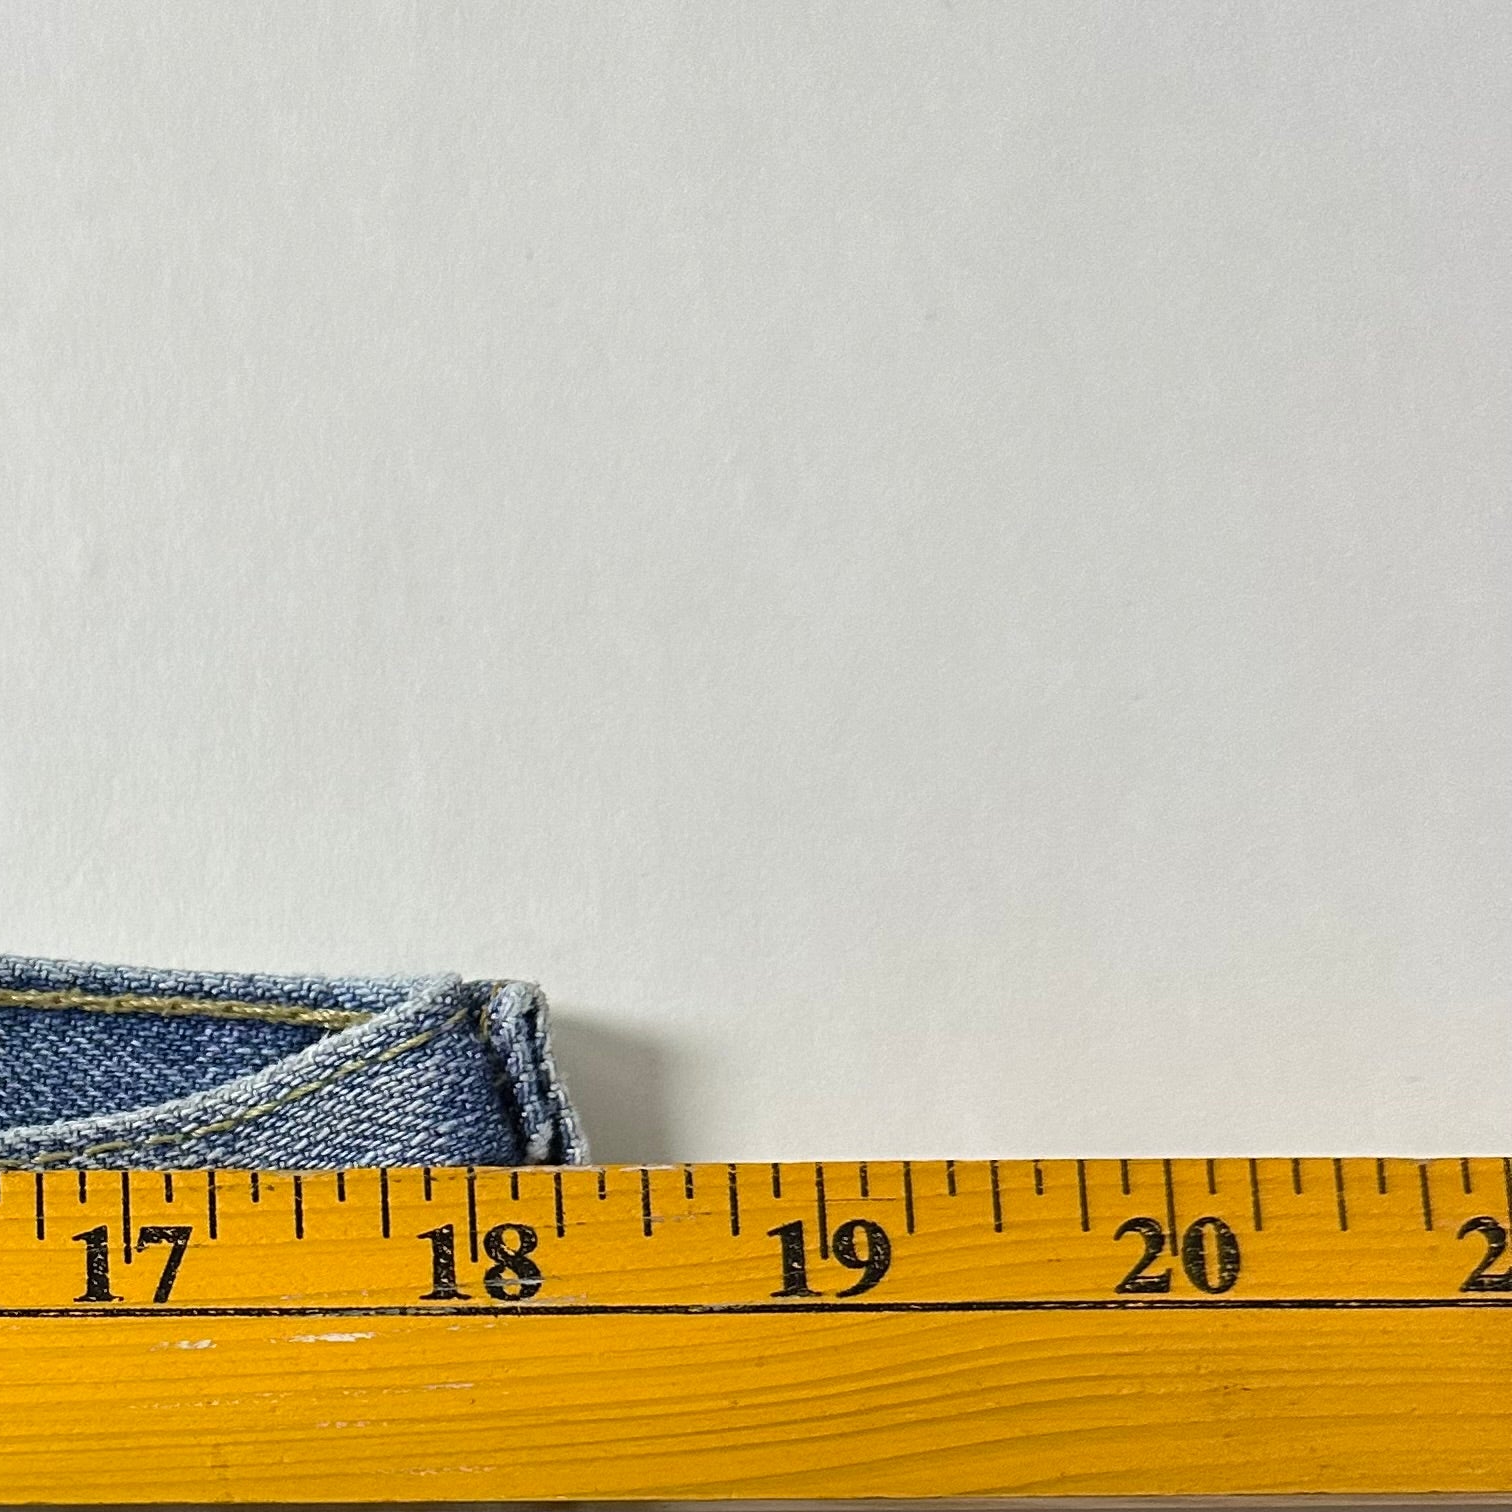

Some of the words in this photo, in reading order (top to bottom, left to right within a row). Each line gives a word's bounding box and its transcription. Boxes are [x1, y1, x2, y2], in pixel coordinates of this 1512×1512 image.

[72, 1225, 193, 1303] 17
[417, 1223, 543, 1302] 18
[767, 1219, 892, 1298] 19
[1114, 1216, 1241, 1295] 20
